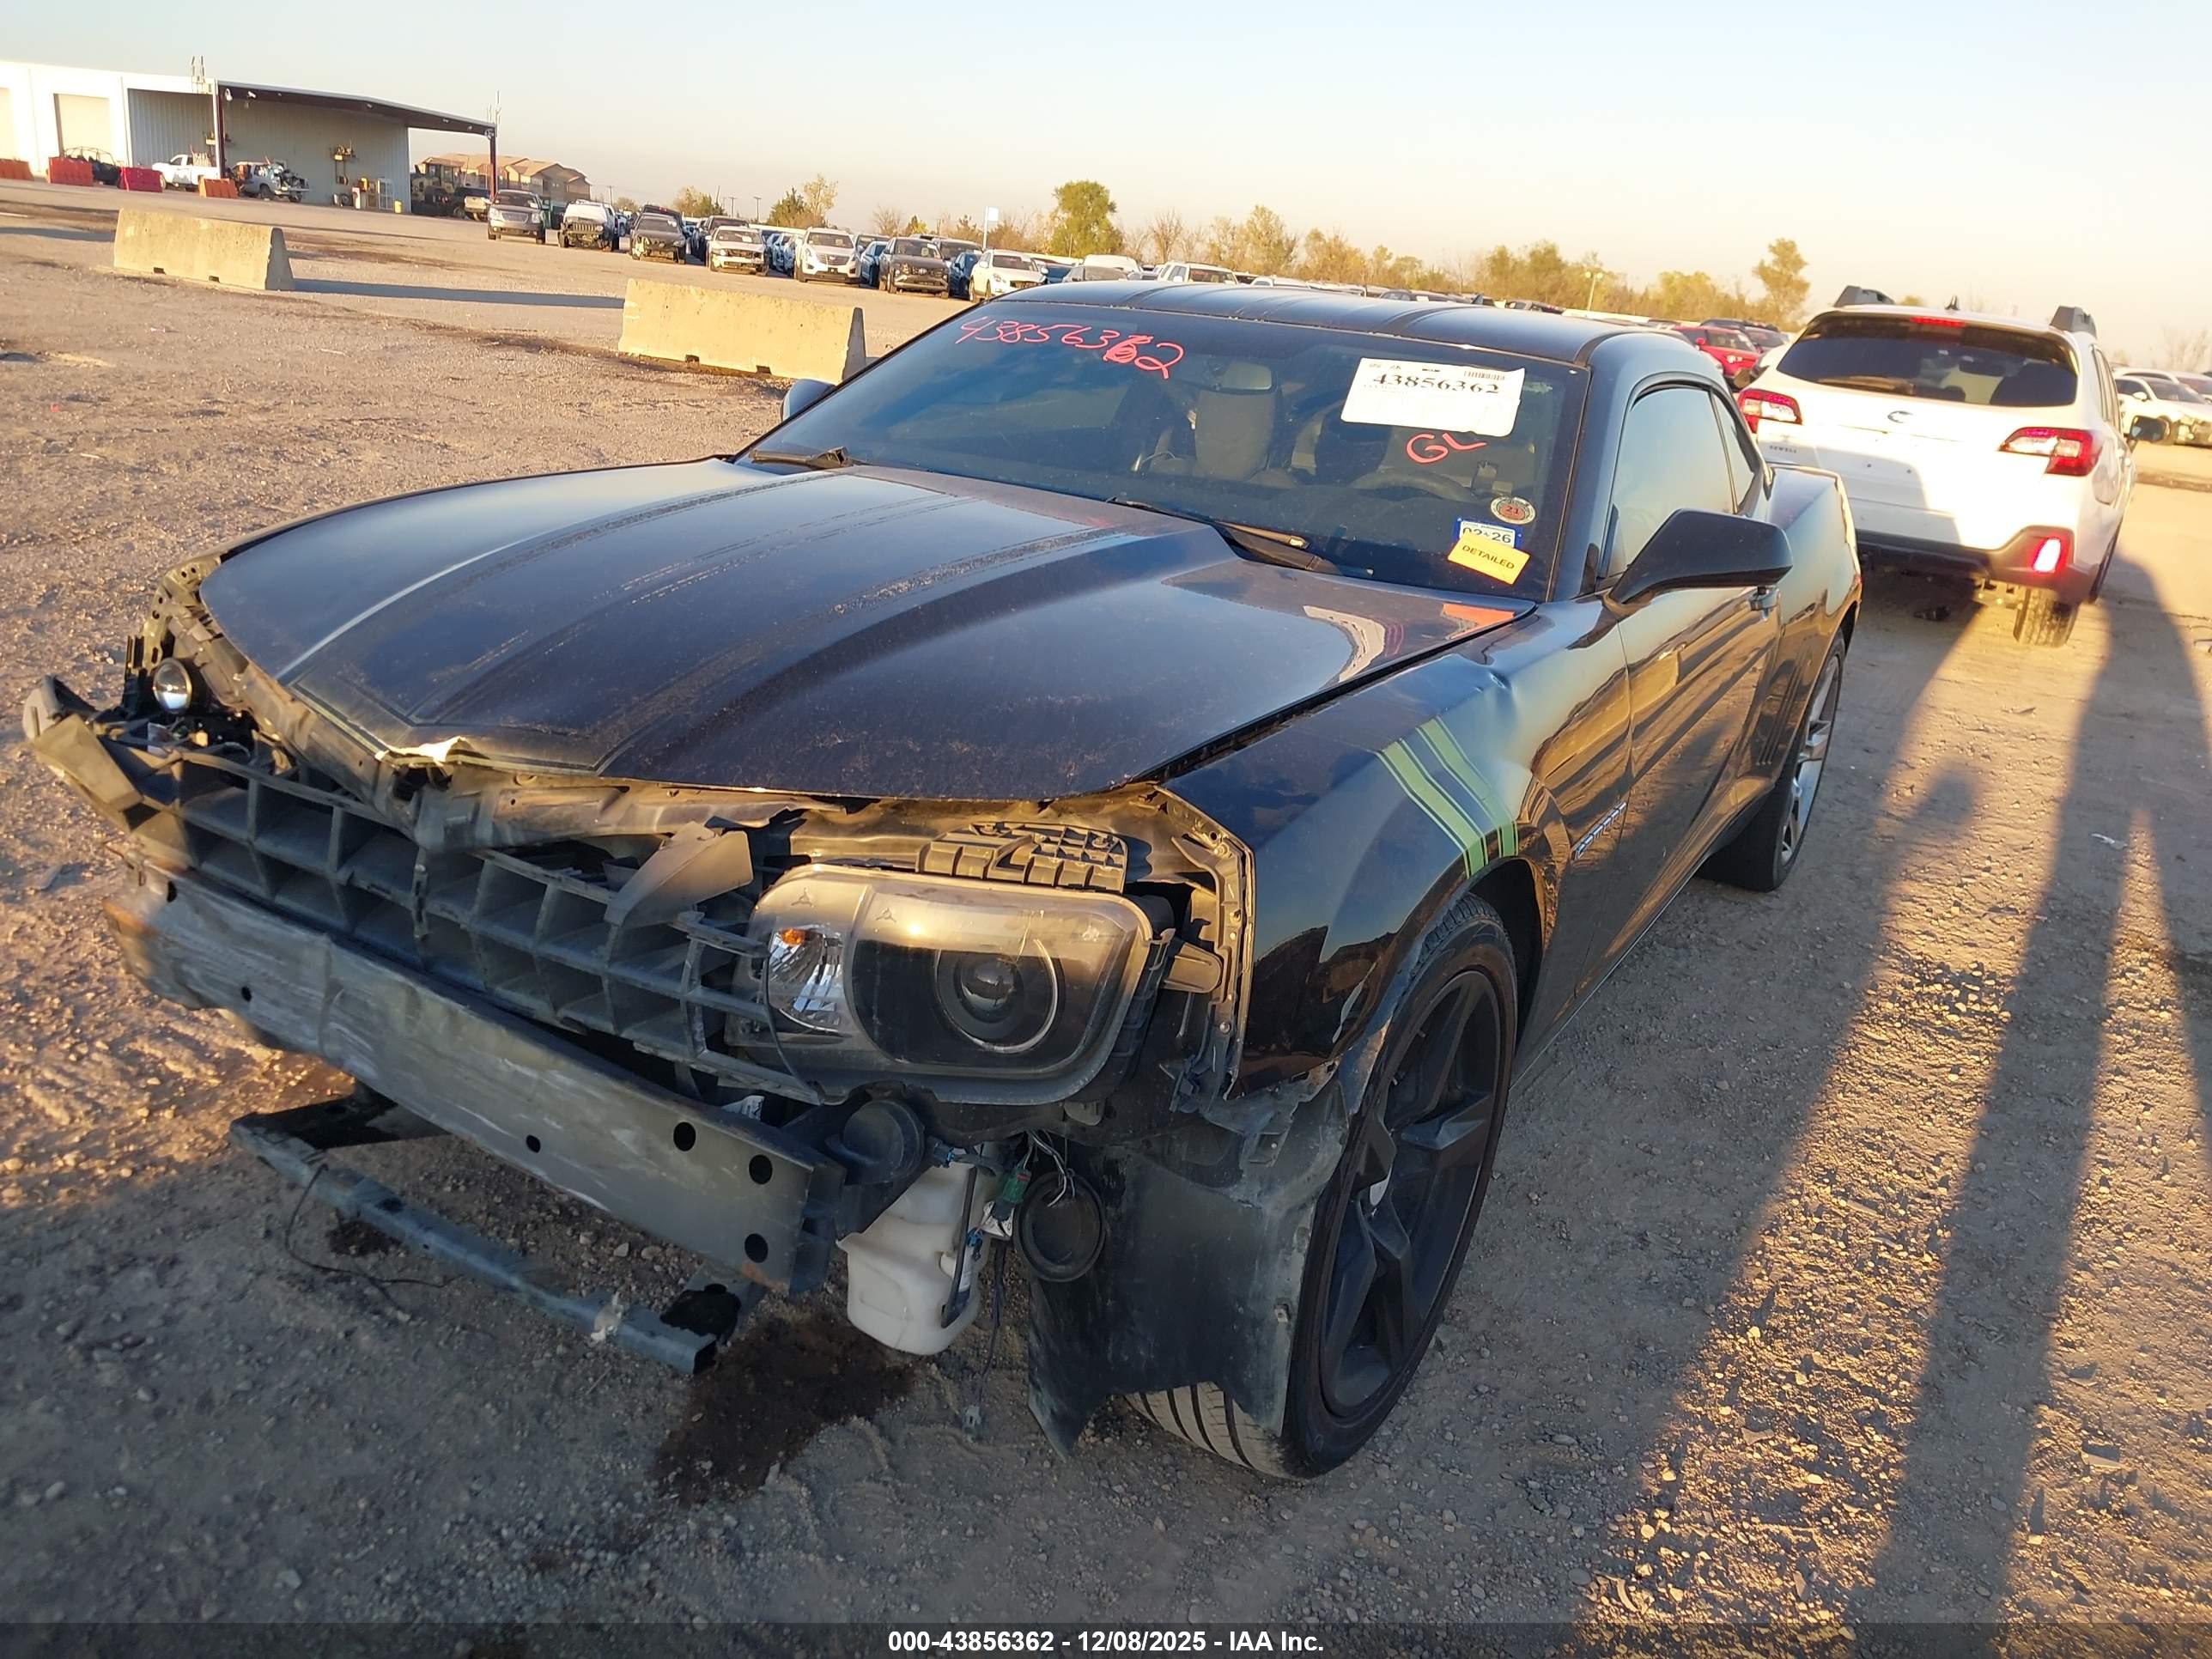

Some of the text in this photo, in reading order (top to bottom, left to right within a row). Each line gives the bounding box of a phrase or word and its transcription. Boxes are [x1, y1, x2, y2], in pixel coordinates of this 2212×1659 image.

[1373, 374, 1499, 394] 43856362
[1492, 532, 1512, 544] 26
[1462, 544, 1515, 569] DETAILED
